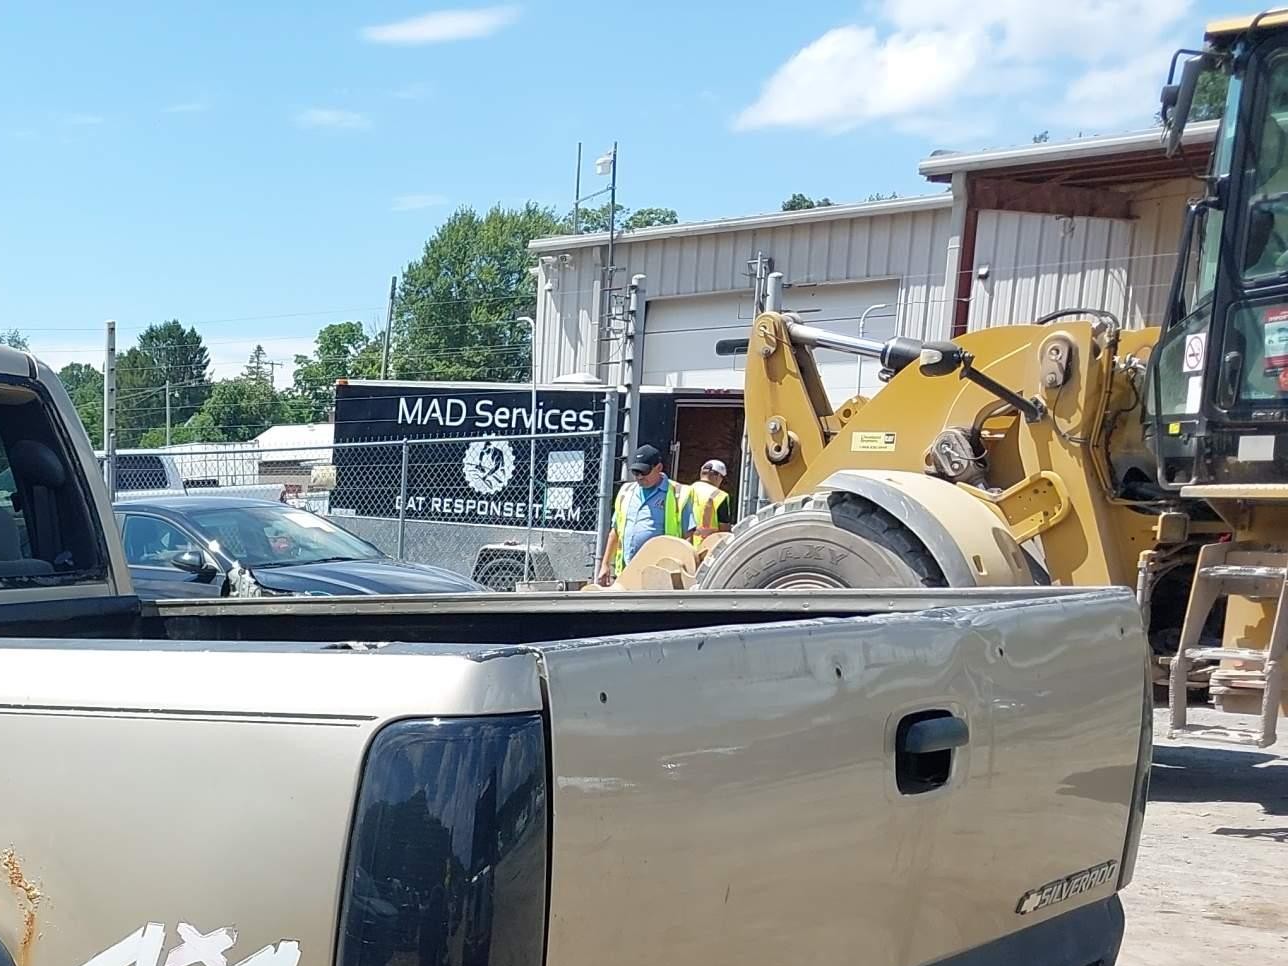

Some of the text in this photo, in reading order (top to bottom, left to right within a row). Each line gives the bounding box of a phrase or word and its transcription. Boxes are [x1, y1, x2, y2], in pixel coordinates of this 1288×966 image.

[397, 397, 594, 432] MAD Services
[431, 499, 526, 518] RESPONSE
[1037, 860, 1118, 909] SILVERADO
